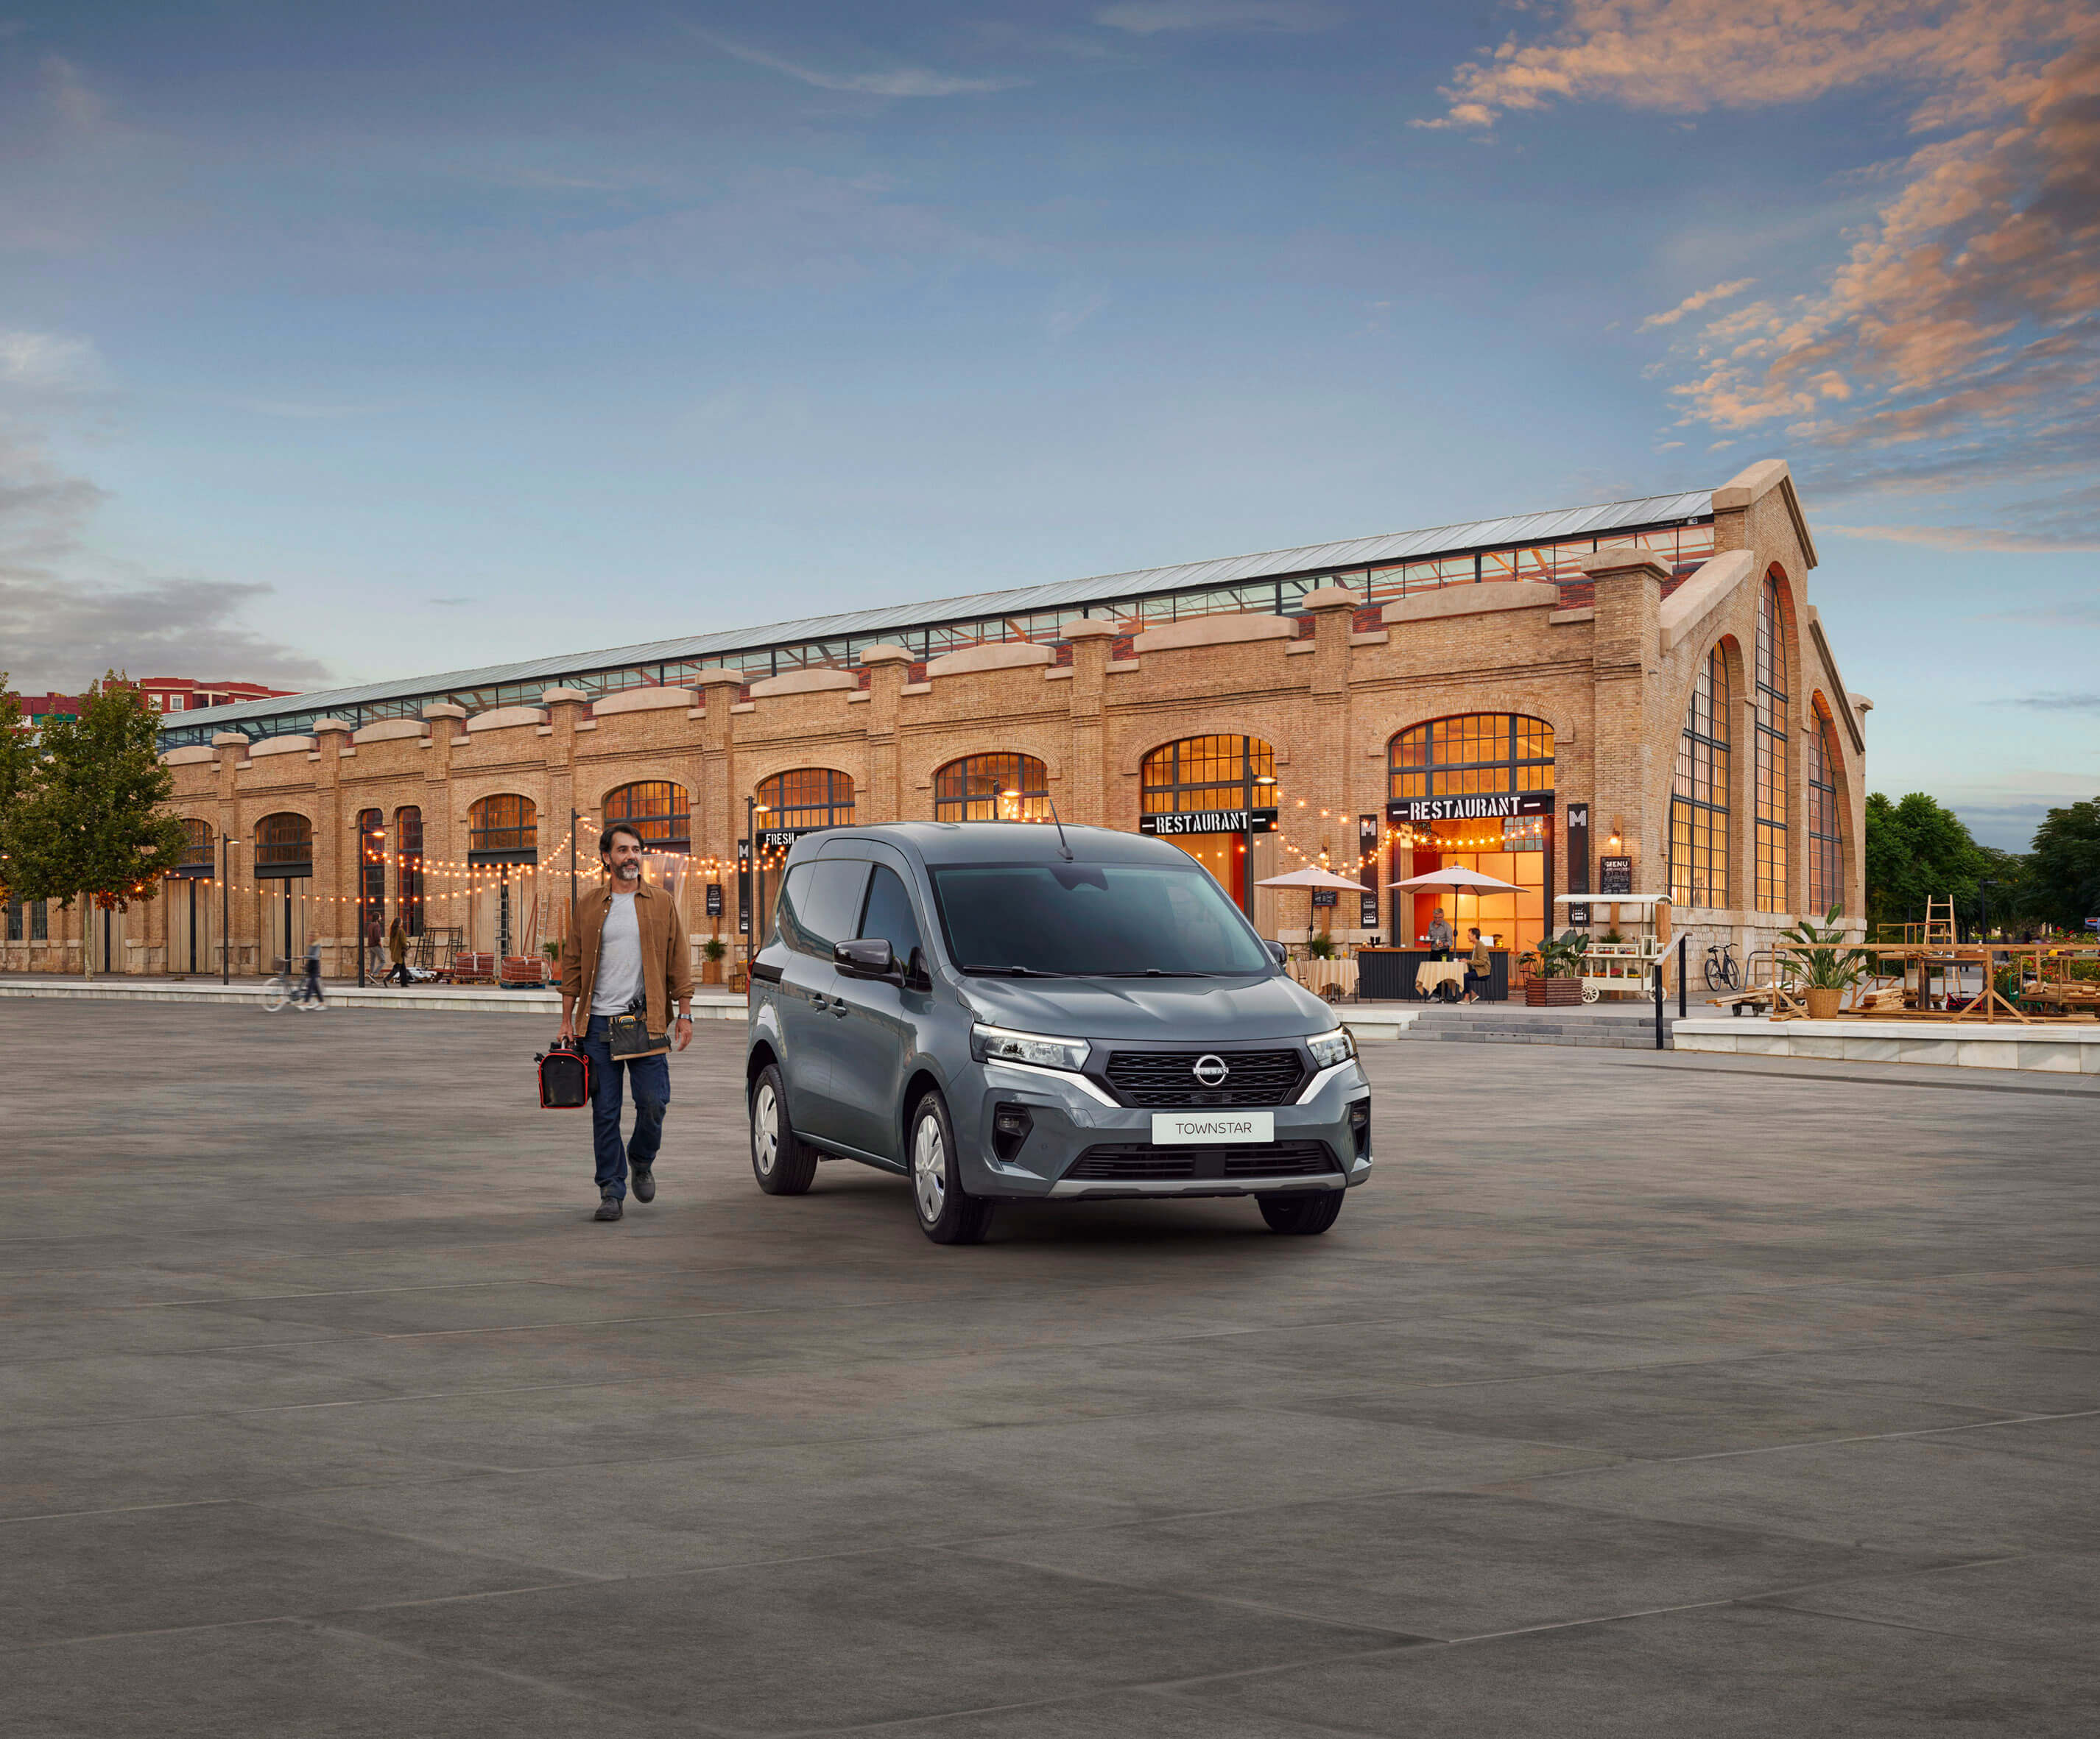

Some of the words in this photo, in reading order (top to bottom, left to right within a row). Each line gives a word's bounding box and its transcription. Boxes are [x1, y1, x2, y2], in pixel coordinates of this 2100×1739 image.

[1410, 796, 1521, 820] RESTAURANT
[1156, 812, 1248, 833] RESTAURANT
[1568, 811, 1587, 828] M
[1361, 820, 1376, 836] M
[766, 832, 794, 845] FRESH
[1193, 1067, 1229, 1075] NISSAN
[1175, 1122, 1252, 1135] TOWNSTAR
